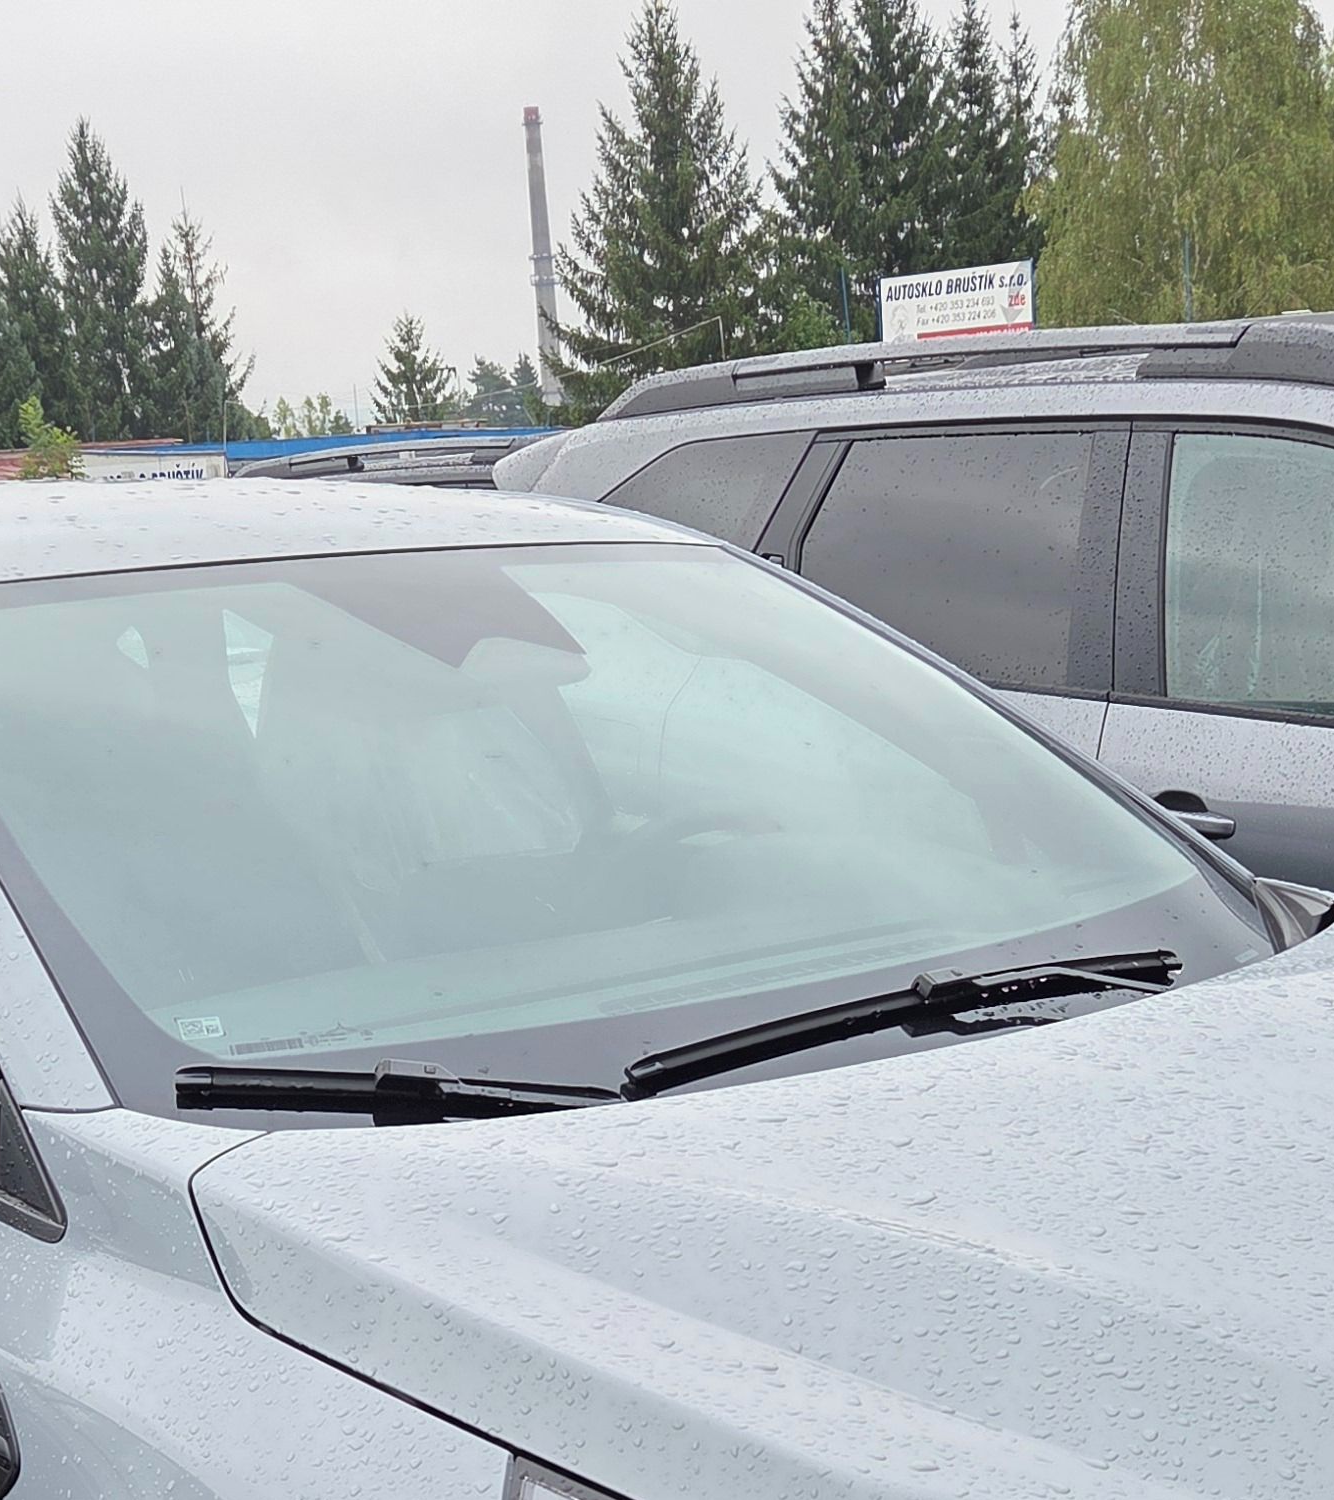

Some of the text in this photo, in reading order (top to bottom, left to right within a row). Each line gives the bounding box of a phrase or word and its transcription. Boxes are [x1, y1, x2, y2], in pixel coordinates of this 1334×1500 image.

[886, 270, 1027, 302] AUTOSKLO BRUŠTÍK s.r.o.
[1008, 292, 1026, 307] zde
